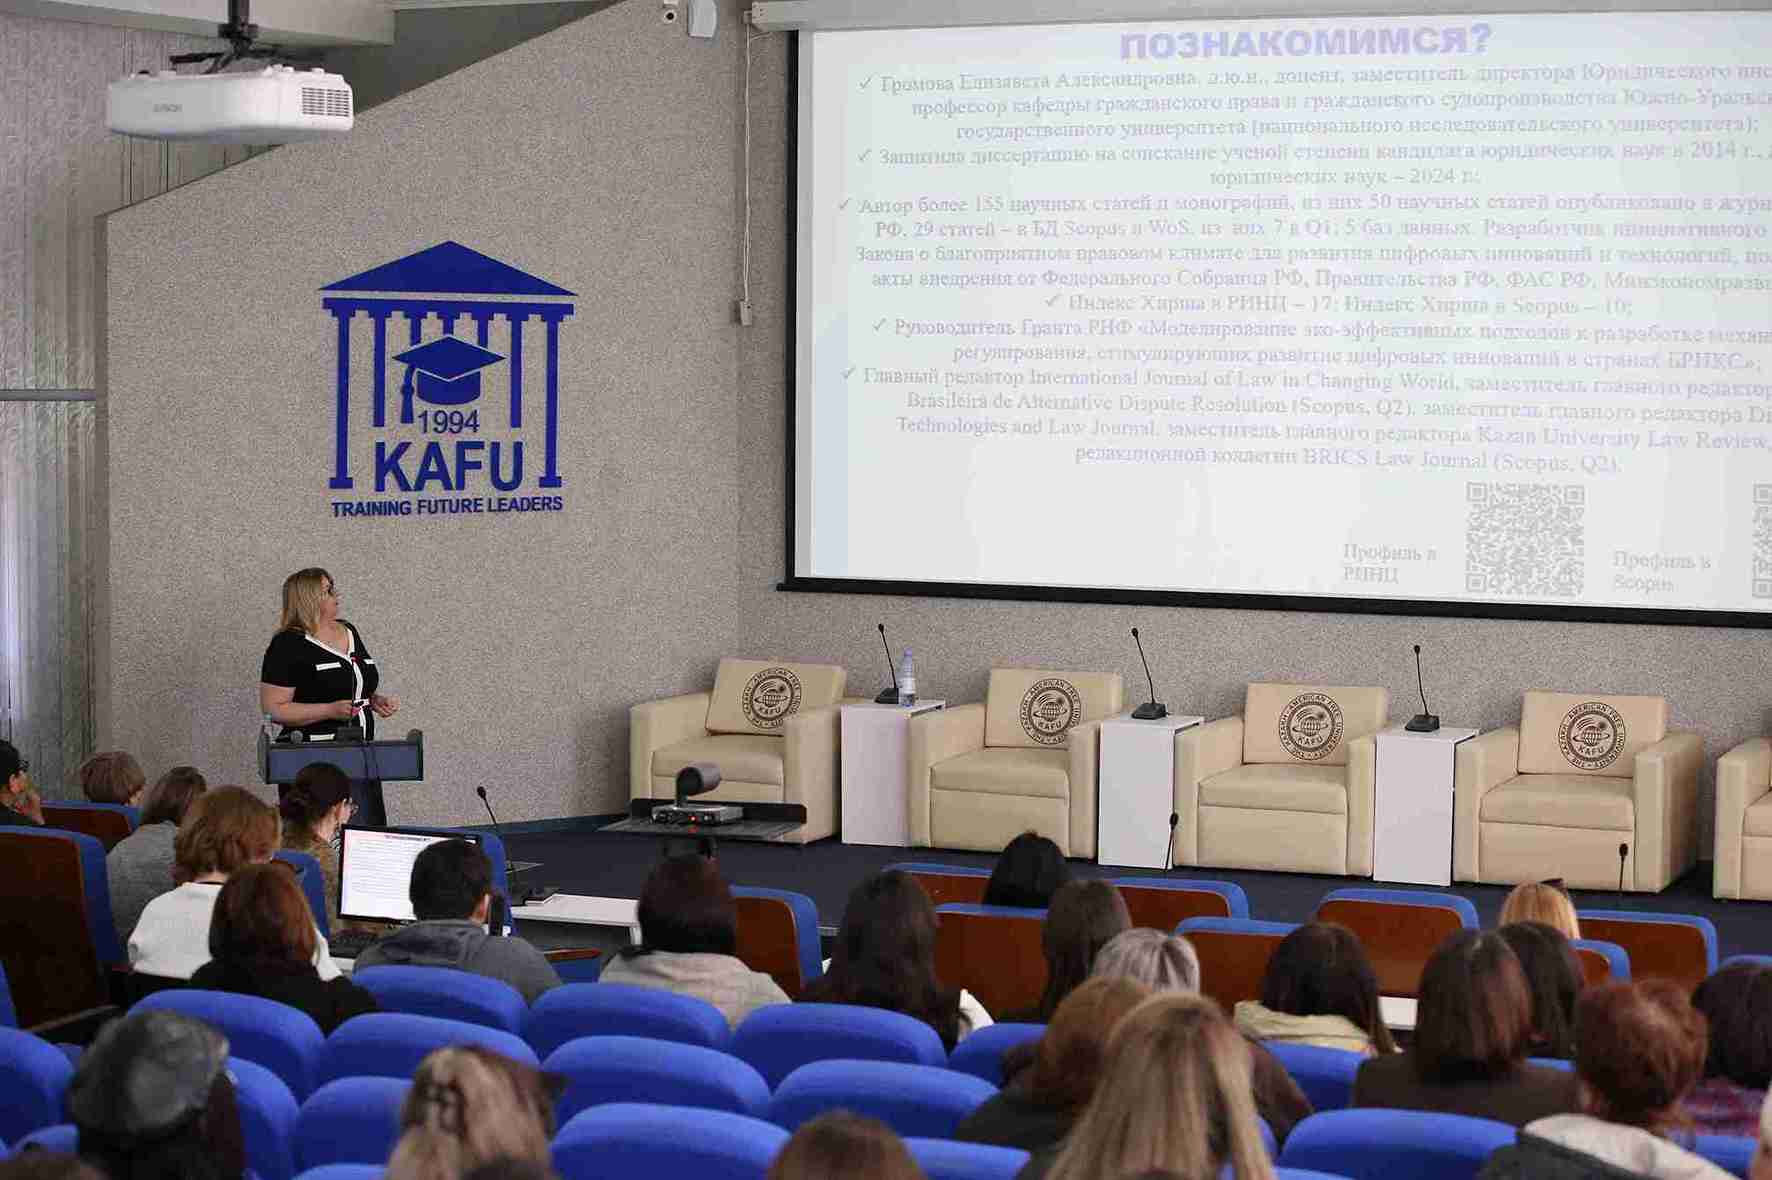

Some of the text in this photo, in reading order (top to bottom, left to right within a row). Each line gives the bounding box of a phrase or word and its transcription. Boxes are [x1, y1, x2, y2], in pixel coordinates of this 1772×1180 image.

[1120, 23, 1493, 59] ПОЗНАКОМИМСЯ?
[911, 95, 1009, 118] профессор
[1012, 94, 1091, 117] кафедры
[1094, 97, 1223, 116] гражданского
[956, 124, 1116, 142] государственного
[1095, 149, 1117, 161] на
[1690, 138, 1736, 157] 2014
[1409, 166, 1456, 183] 2024
[857, 195, 914, 216] Автор
[917, 194, 969, 211] более
[1368, 192, 1392, 210] 50
[1028, 367, 1139, 386] International
[1142, 369, 1209, 387] Journal
[1213, 370, 1233, 387] of
[1237, 370, 1277, 388] Law
[991, 392, 1014, 409] de
[417, 409, 480, 434] 1994
[895, 414, 1009, 438] Technologies
[1011, 416, 1044, 434] and
[1047, 417, 1086, 435] Law
[375, 440, 523, 492] KAFU
[331, 495, 563, 518] TRAINING FUTURE LEADERS
[1576, 743, 1606, 755] KAFU
